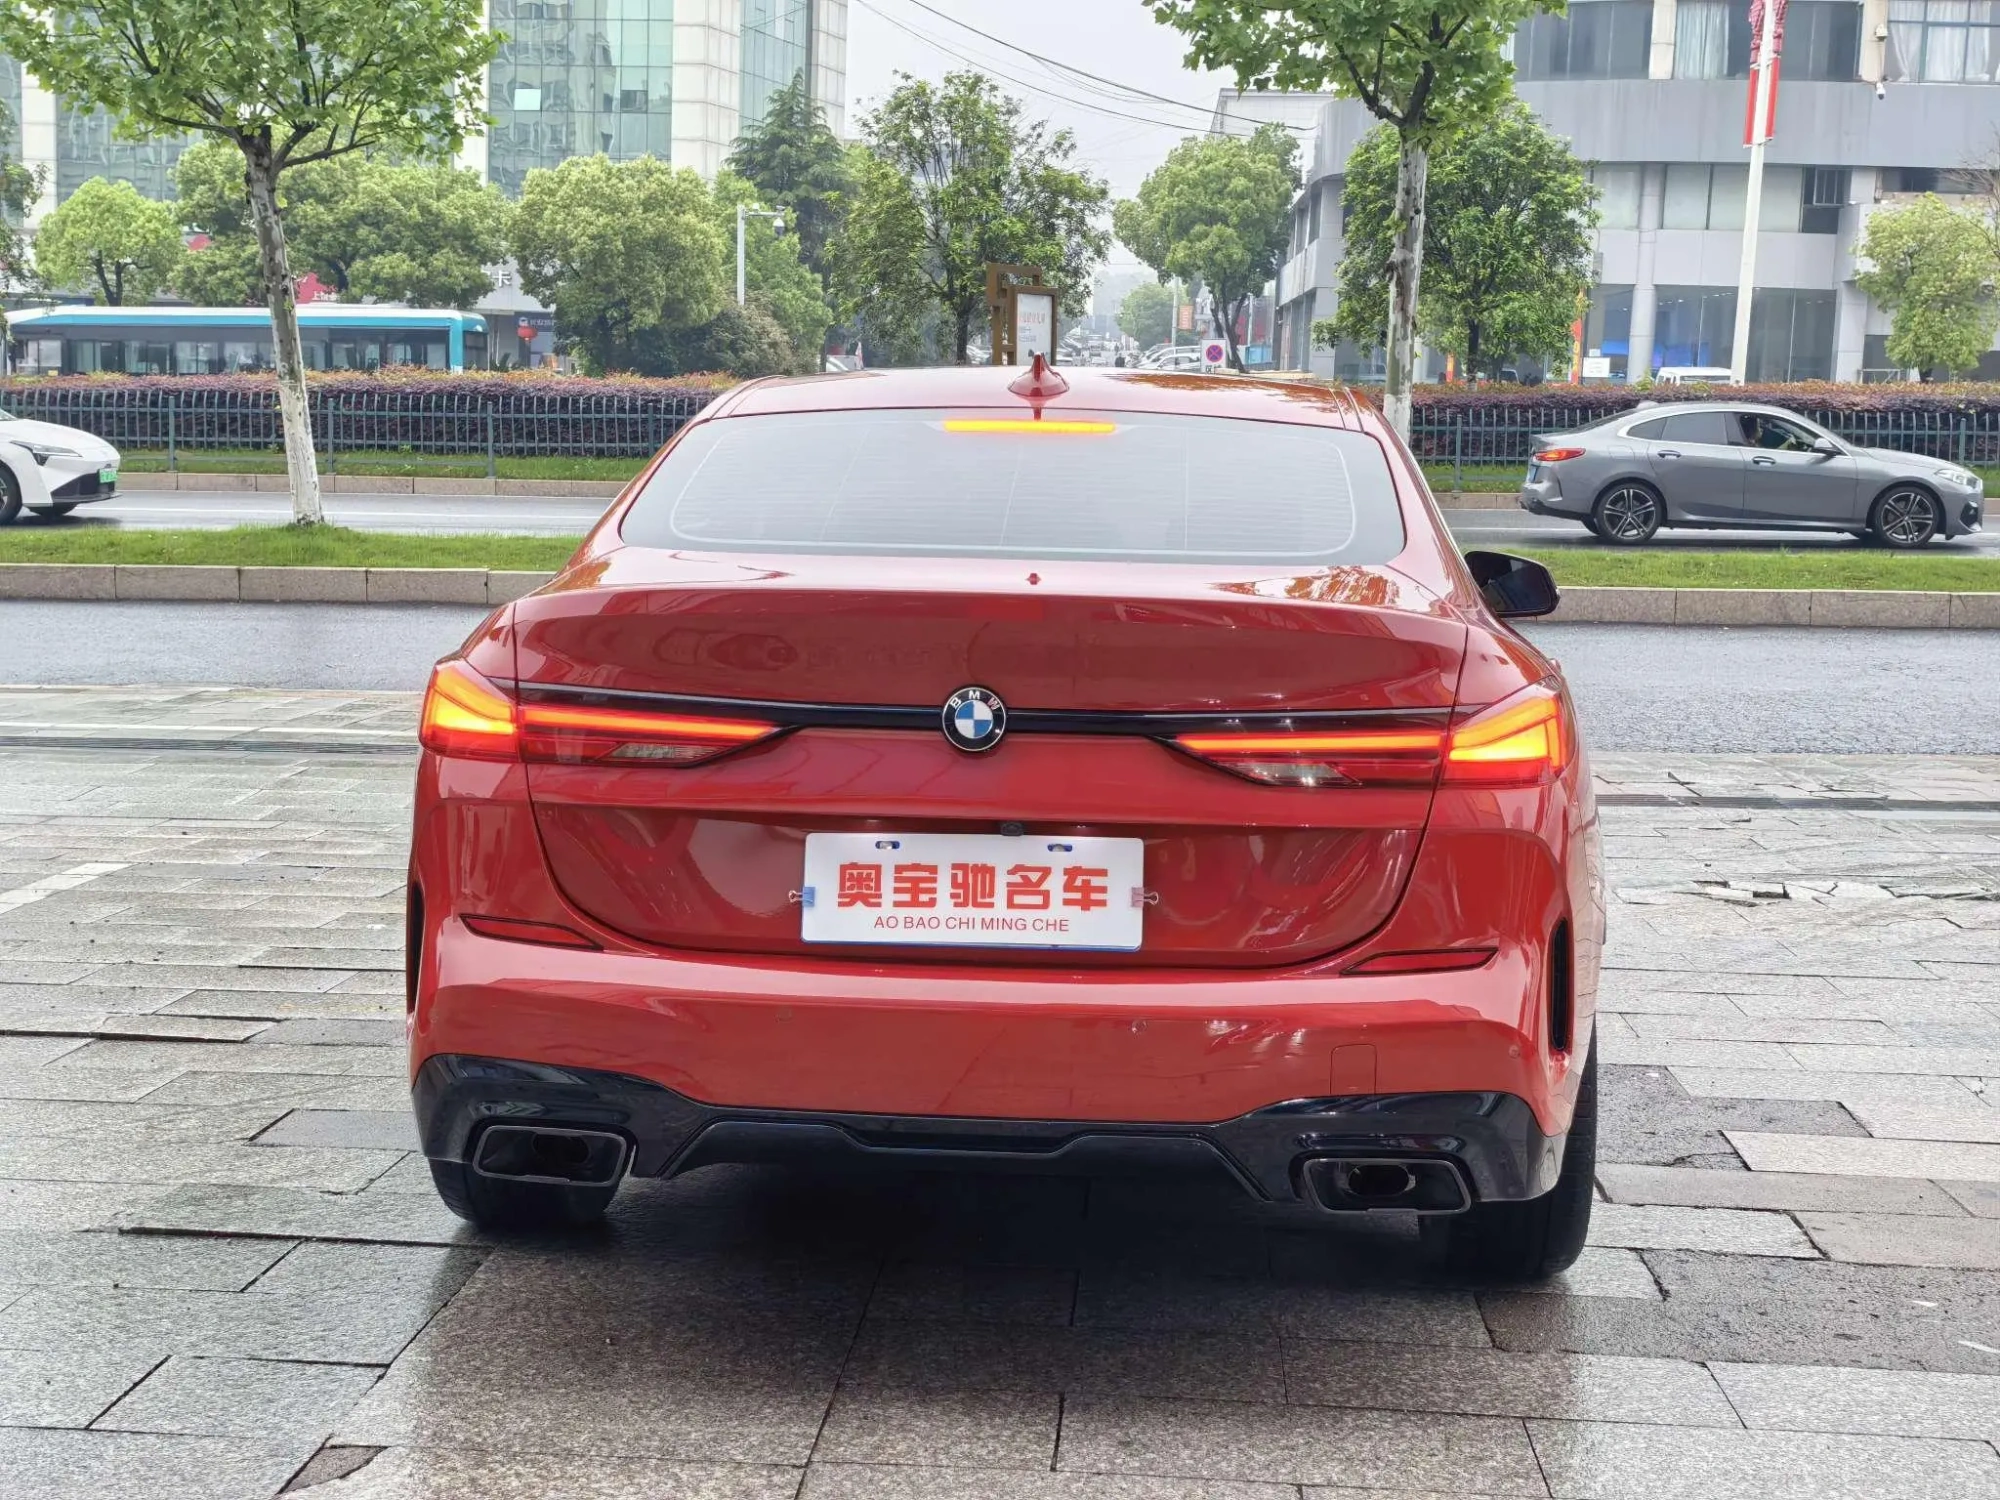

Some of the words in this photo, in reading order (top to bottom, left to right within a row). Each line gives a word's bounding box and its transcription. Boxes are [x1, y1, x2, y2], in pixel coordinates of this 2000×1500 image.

[949, 690, 1001, 710] BMW
[837, 861, 1109, 912] 奥宝驰名车
[873, 915, 899, 929] AO
[903, 916, 941, 930] BAO
[945, 916, 975, 930] CHI
[981, 917, 1028, 931] MING
[1032, 918, 1070, 932] CHE
